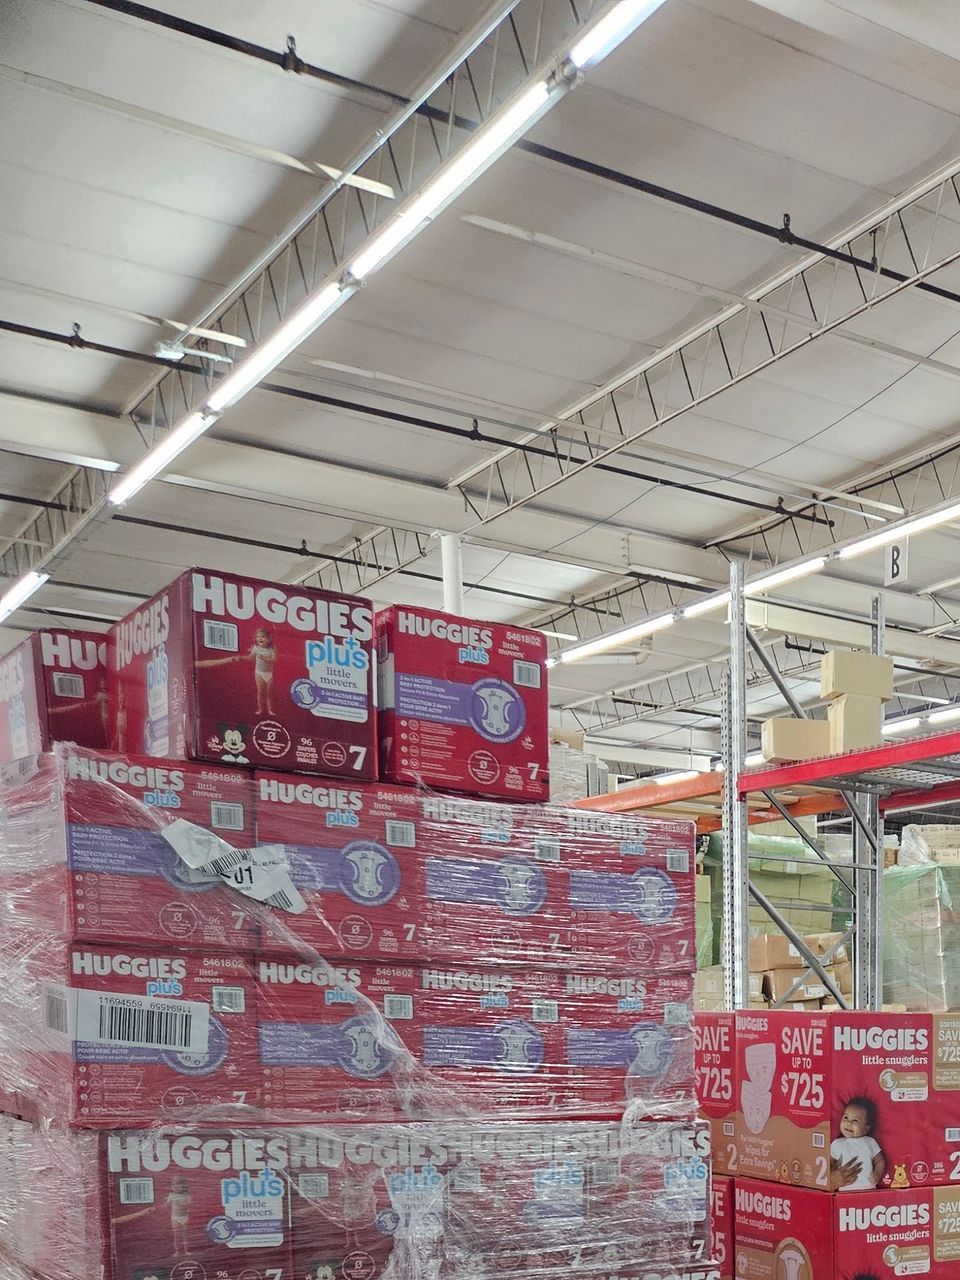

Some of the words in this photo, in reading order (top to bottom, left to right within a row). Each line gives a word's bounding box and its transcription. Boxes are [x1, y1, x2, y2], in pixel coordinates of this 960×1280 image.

[892, 545, 900, 579] B
[192, 573, 373, 641] HUGGIES
[398, 611, 493, 649] HUGGIES
[306, 635, 369, 669] plus
[320, 675, 358, 689] movers
[326, 667, 351, 679] little
[301, 738, 312, 746] 96
[349, 745, 367, 770] 7
[67, 756, 184, 792] HUGGIES
[527, 762, 539, 780] 7
[259, 779, 363, 811] HUGGIES
[72, 952, 187, 979] HUGGIES
[199, 968, 218, 977] little
[203, 958, 244, 969] 5461802
[376, 968, 413, 978] 5461802
[194, 975, 224, 984] movers
[260, 962, 361, 987] HUGGIES
[147, 977, 183, 997] plus
[566, 974, 646, 996] HUGGIES
[99, 996, 143, 1008] 11694559
[481, 992, 508, 1008] plus
[781, 1027, 823, 1055] SAVE
[833, 1026, 929, 1051] HUGGIES
[792, 1057, 801, 1068] UP
[801, 1057, 812, 1069] TO
[862, 1055, 884, 1066] little
[885, 1055, 928, 1067] snugglers
[781, 1072, 824, 1108] $725
[108, 1136, 288, 1172] HUGGIES
[223, 1168, 282, 1203] plus
[236, 1208, 274, 1218] movers
[242, 1200, 267, 1209] little
[839, 1203, 930, 1232] HUGGIES
[867, 1232, 888, 1243] little
[889, 1229, 930, 1242] snugglers
[216, 1271, 228, 1279] 96
